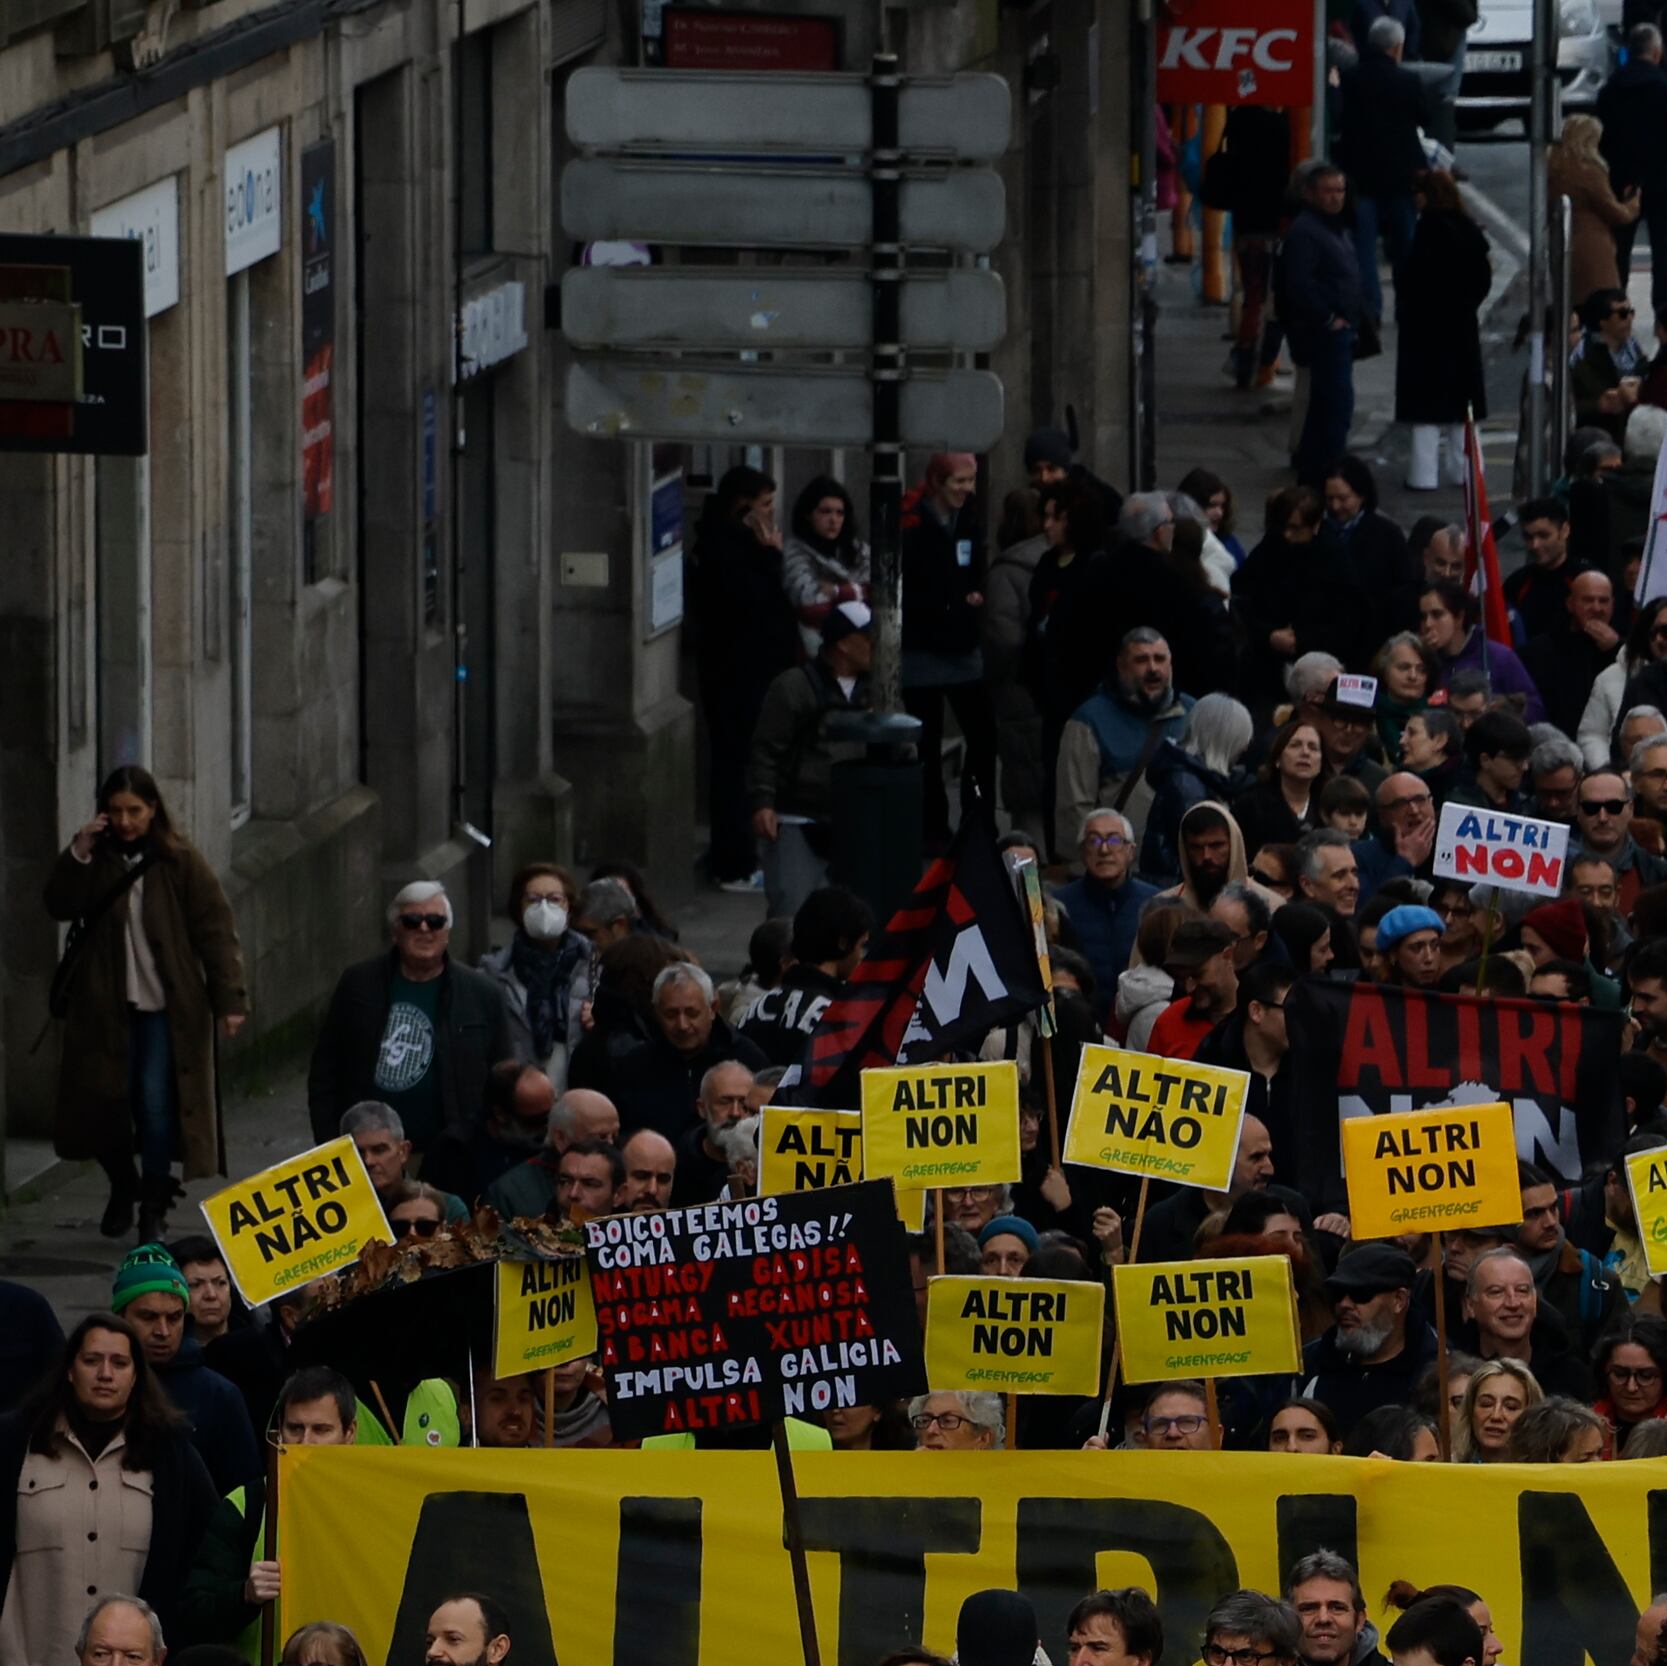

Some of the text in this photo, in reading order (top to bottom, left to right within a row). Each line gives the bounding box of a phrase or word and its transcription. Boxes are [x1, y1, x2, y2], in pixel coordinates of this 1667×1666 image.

[1158, 26, 1299, 71] KFC
[1338, 983, 1583, 1102] ALTRI
[893, 1076, 987, 1112] ALTRI
[1092, 1064, 1228, 1117] ALTRI
[775, 1124, 861, 1161] ALT
[906, 1115, 980, 1149] NON
[1104, 1104, 1202, 1149] NÃO
[1374, 1121, 1480, 1160] ALTRI
[794, 1159, 862, 1190] NÃ
[902, 1160, 982, 1179] GREENPEACE
[1098, 1147, 1196, 1175] GREENPEACE
[1387, 1159, 1476, 1196] NON
[229, 1156, 353, 1236] ALTRI
[1390, 1199, 1485, 1223] GREENPEACE
[252, 1200, 349, 1263] NÃO
[585, 1197, 779, 1249] BOICOTEEMOS
[597, 1213, 853, 1269] COMA GALEGAS!!
[271, 1239, 359, 1289] GREENPEACE
[521, 1261, 580, 1298] ALTRI
[592, 1241, 865, 1302] NATURGY GADISA
[599, 1278, 871, 1335] SOGAMA REGANOSA
[961, 1289, 1067, 1322] ALTRI
[1150, 1269, 1253, 1306] ALTRI
[528, 1289, 577, 1332] NON
[1165, 1306, 1246, 1342] NON
[522, 1336, 578, 1361] GREENPEACE
[628, 1321, 730, 1364] BANCA
[764, 1308, 875, 1351] XUNTA
[973, 1325, 1054, 1356] NON
[614, 1338, 902, 1400] IMPULSA GALICIA
[965, 1368, 1056, 1384] GREENPEACE
[1164, 1350, 1253, 1370] GREENPEACE
[664, 1374, 857, 1432] ALTRI NON
